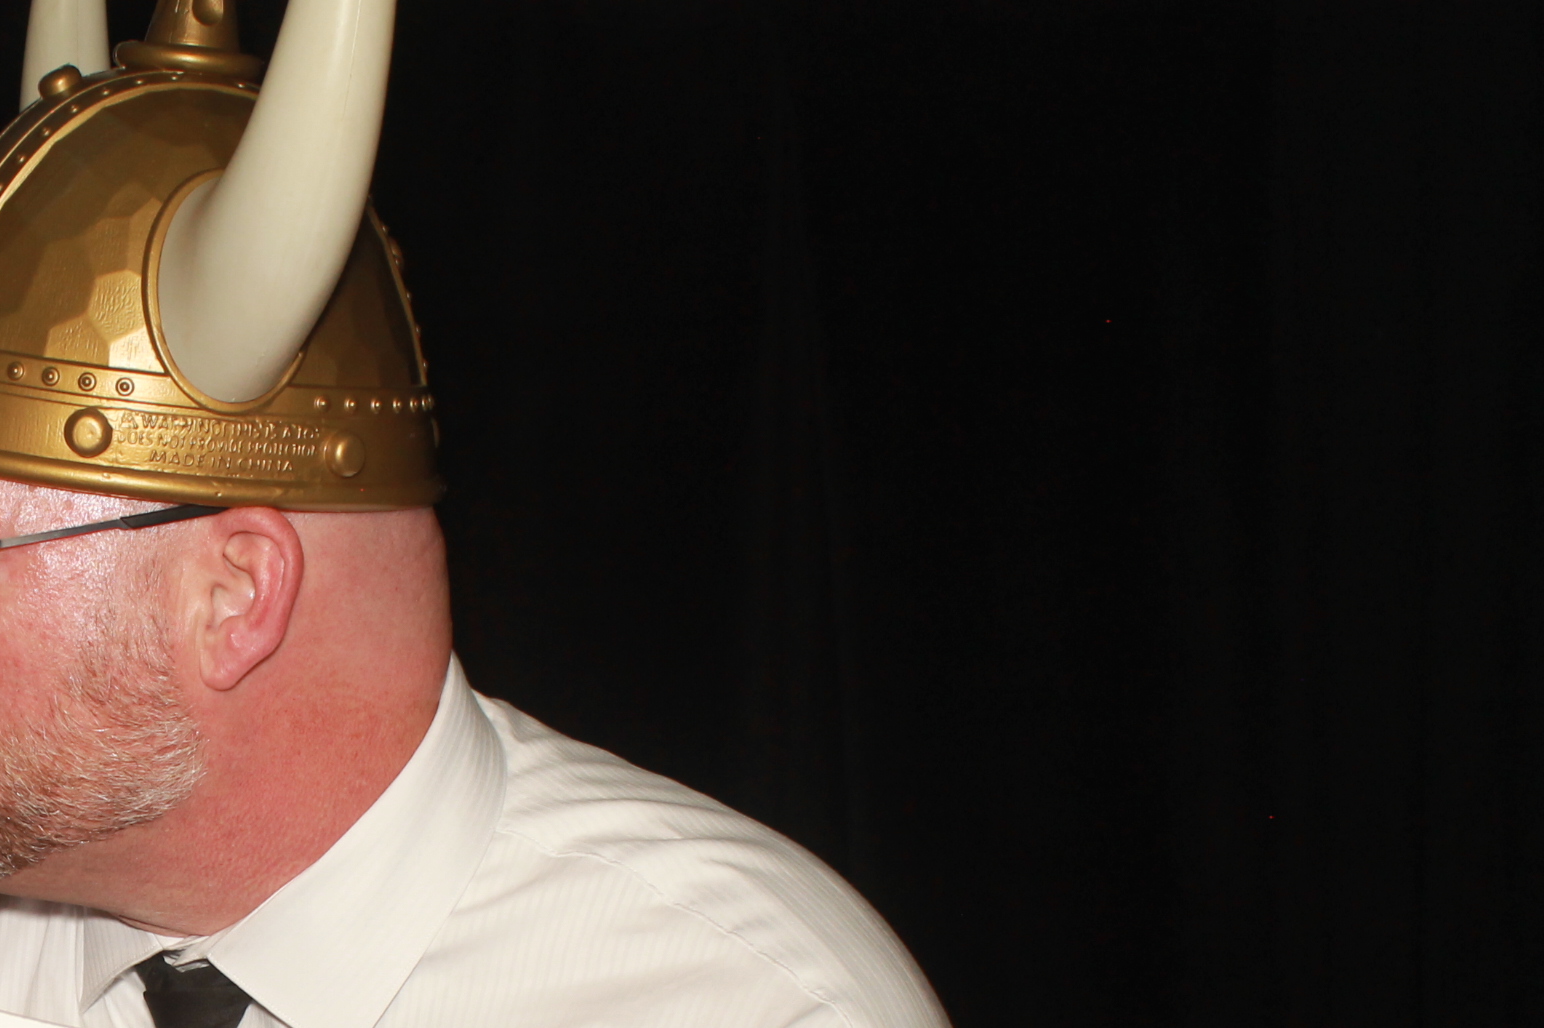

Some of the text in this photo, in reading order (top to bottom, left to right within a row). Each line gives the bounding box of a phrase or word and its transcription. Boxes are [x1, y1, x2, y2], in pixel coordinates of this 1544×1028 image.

[149, 449, 293, 471] MADE IN CHINA
